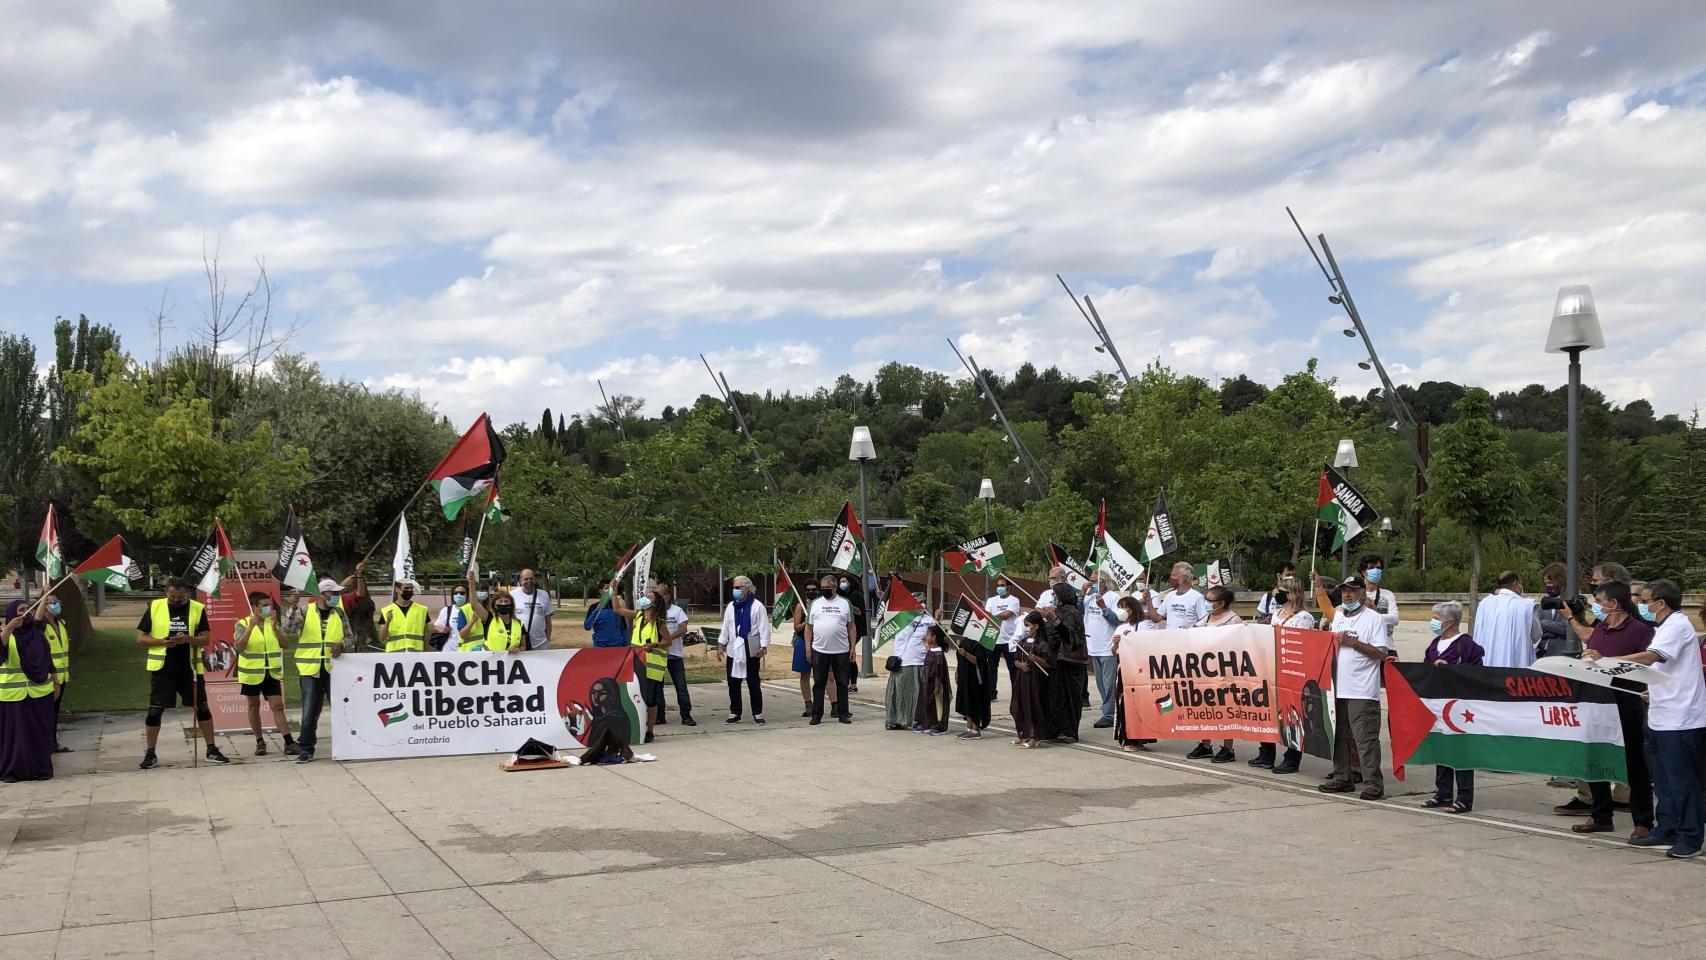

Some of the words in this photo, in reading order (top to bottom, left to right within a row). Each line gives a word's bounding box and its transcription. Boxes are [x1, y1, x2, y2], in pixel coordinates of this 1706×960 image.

[1333, 483, 1365, 516] SAHARA
[1155, 513, 1173, 542] SAHARA
[962, 536, 988, 549] SAHARA
[233, 560, 267, 570] RCHA
[1111, 557, 1134, 580] ertad
[373, 659, 532, 689] MARCHA
[1149, 650, 1257, 680] MARCHA
[373, 692, 394, 703] por
[396, 689, 407, 700] la
[1151, 683, 1164, 692] por
[1173, 679, 1270, 708] libertad
[1504, 675, 1573, 698] SAHARA
[412, 686, 545, 717] libertad
[413, 722, 425, 731] del
[429, 713, 480, 730] Pueblo
[484, 713, 547, 728] Saharaui
[1187, 708, 1224, 721] Pueblo
[407, 735, 451, 745] Cantabria
